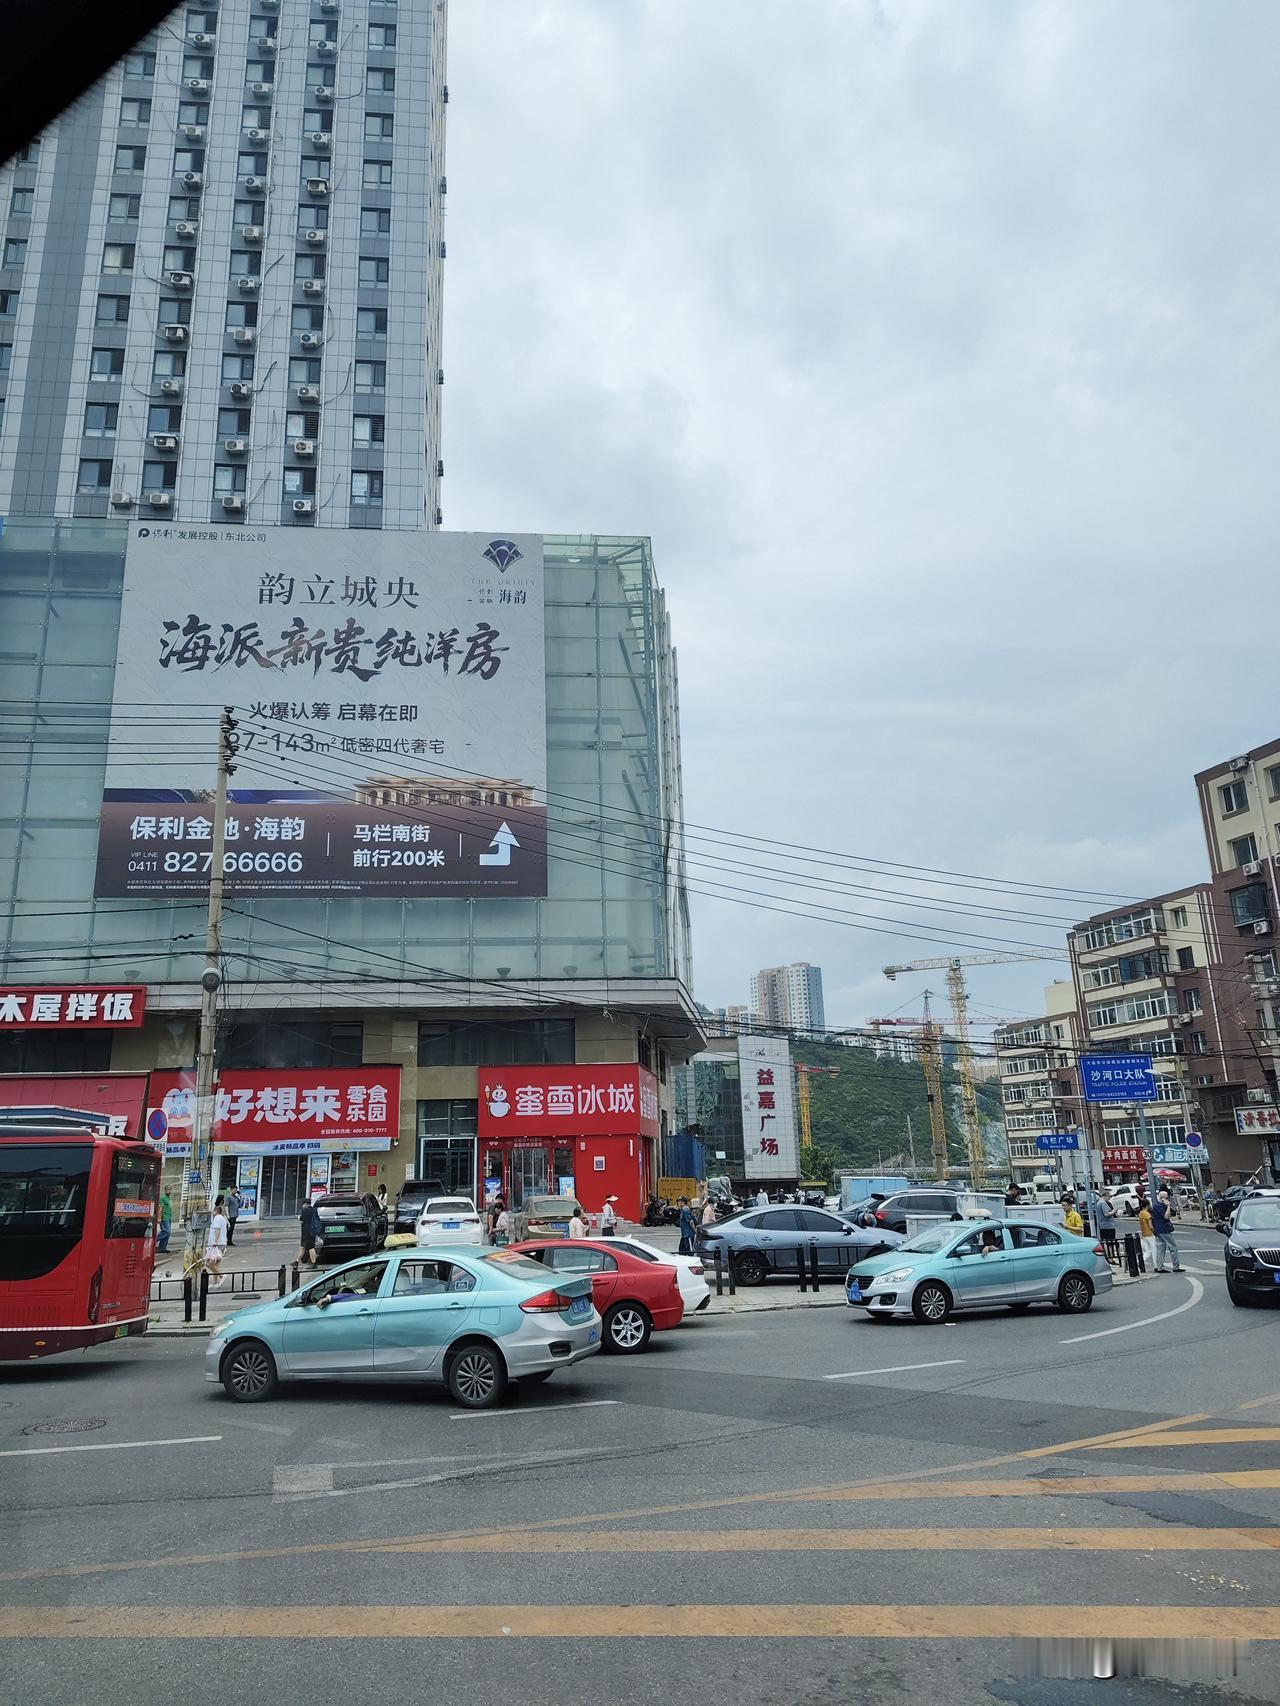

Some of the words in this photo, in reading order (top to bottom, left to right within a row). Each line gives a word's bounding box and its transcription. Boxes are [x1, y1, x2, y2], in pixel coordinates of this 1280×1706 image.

[258, 571, 420, 609] 韵立城央
[158, 613, 511, 682] 海派新贵纯洋房
[337, 702, 418, 722] 启幕在即
[353, 824, 430, 843] 马栏南街
[128, 861, 157, 872] 0411
[353, 849, 445, 868] 前行200米
[1090, 1068, 1146, 1081] 沙河口大队
[346, 1084, 388, 1104] 零食
[515, 1083, 635, 1116] 蜜雪冰城
[213, 1086, 341, 1124] 好想来
[346, 1103, 387, 1122] 乐园
[757, 1068, 779, 1156] 益嘉广场
[1143, 1150, 1152, 1158] 30
